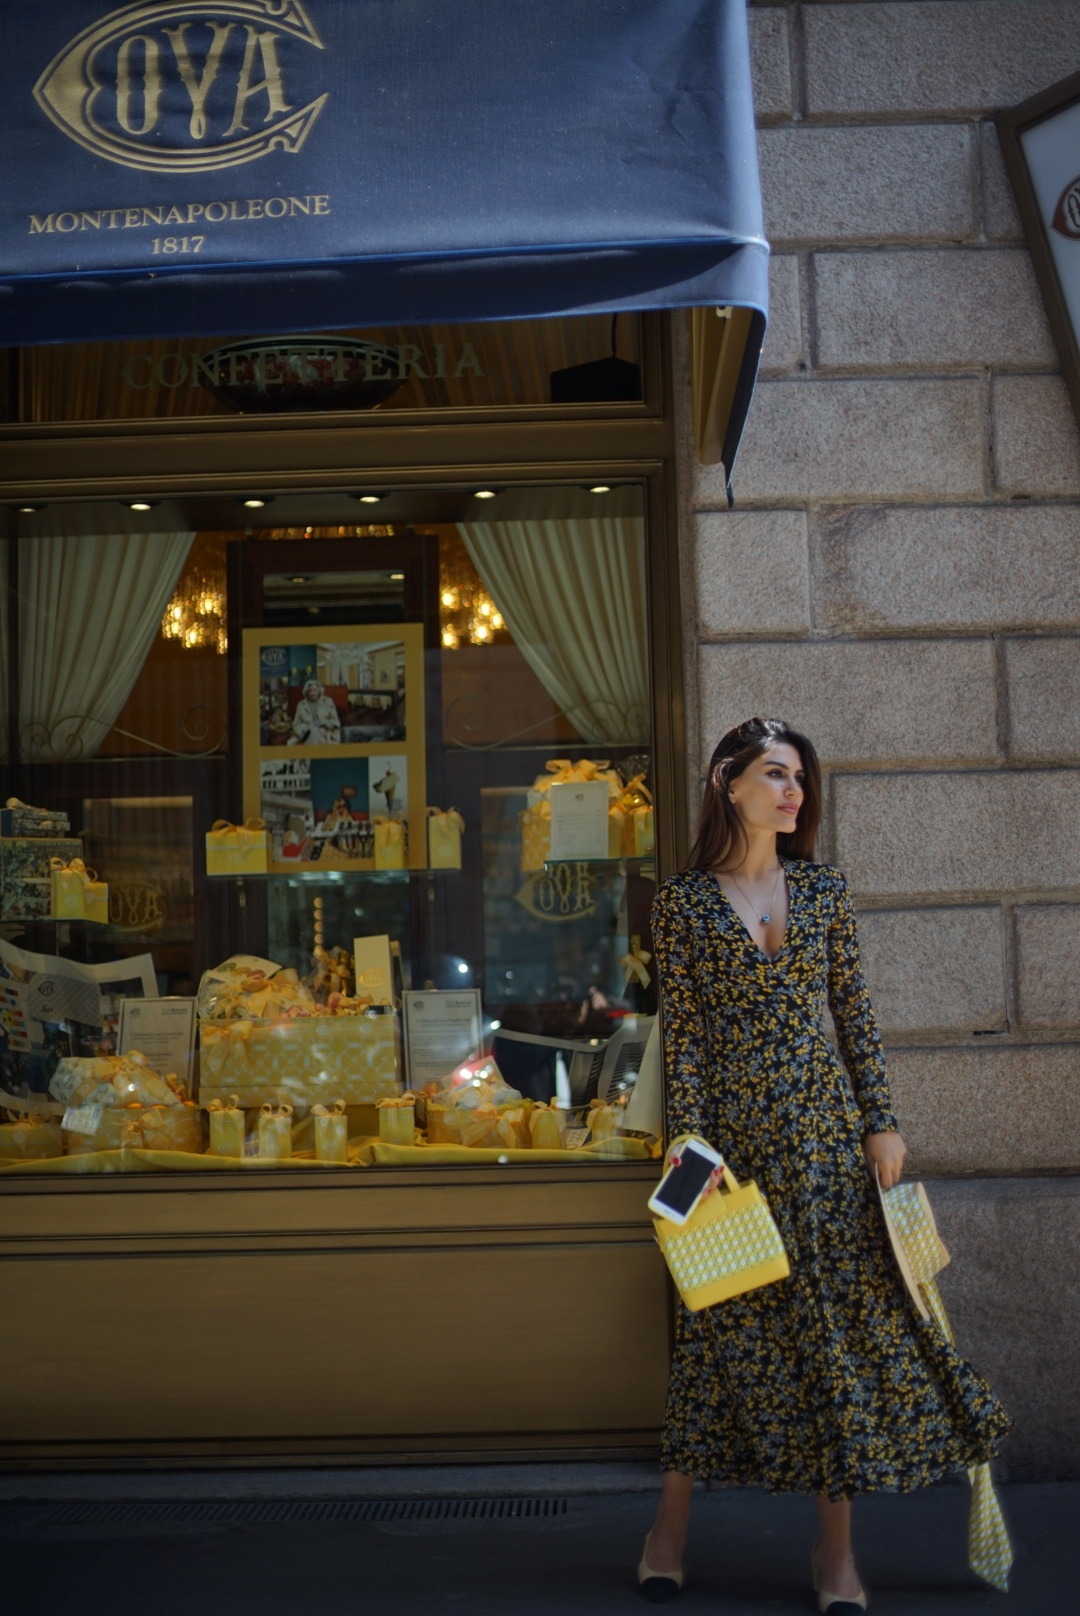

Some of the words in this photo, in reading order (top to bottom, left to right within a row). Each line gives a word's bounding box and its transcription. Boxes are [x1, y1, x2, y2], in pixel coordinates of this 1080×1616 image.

[28, 194, 331, 235] MONTENAPOLEONE
[151, 235, 205, 255] 1817
[121, 341, 487, 391] CONFETTERIA
